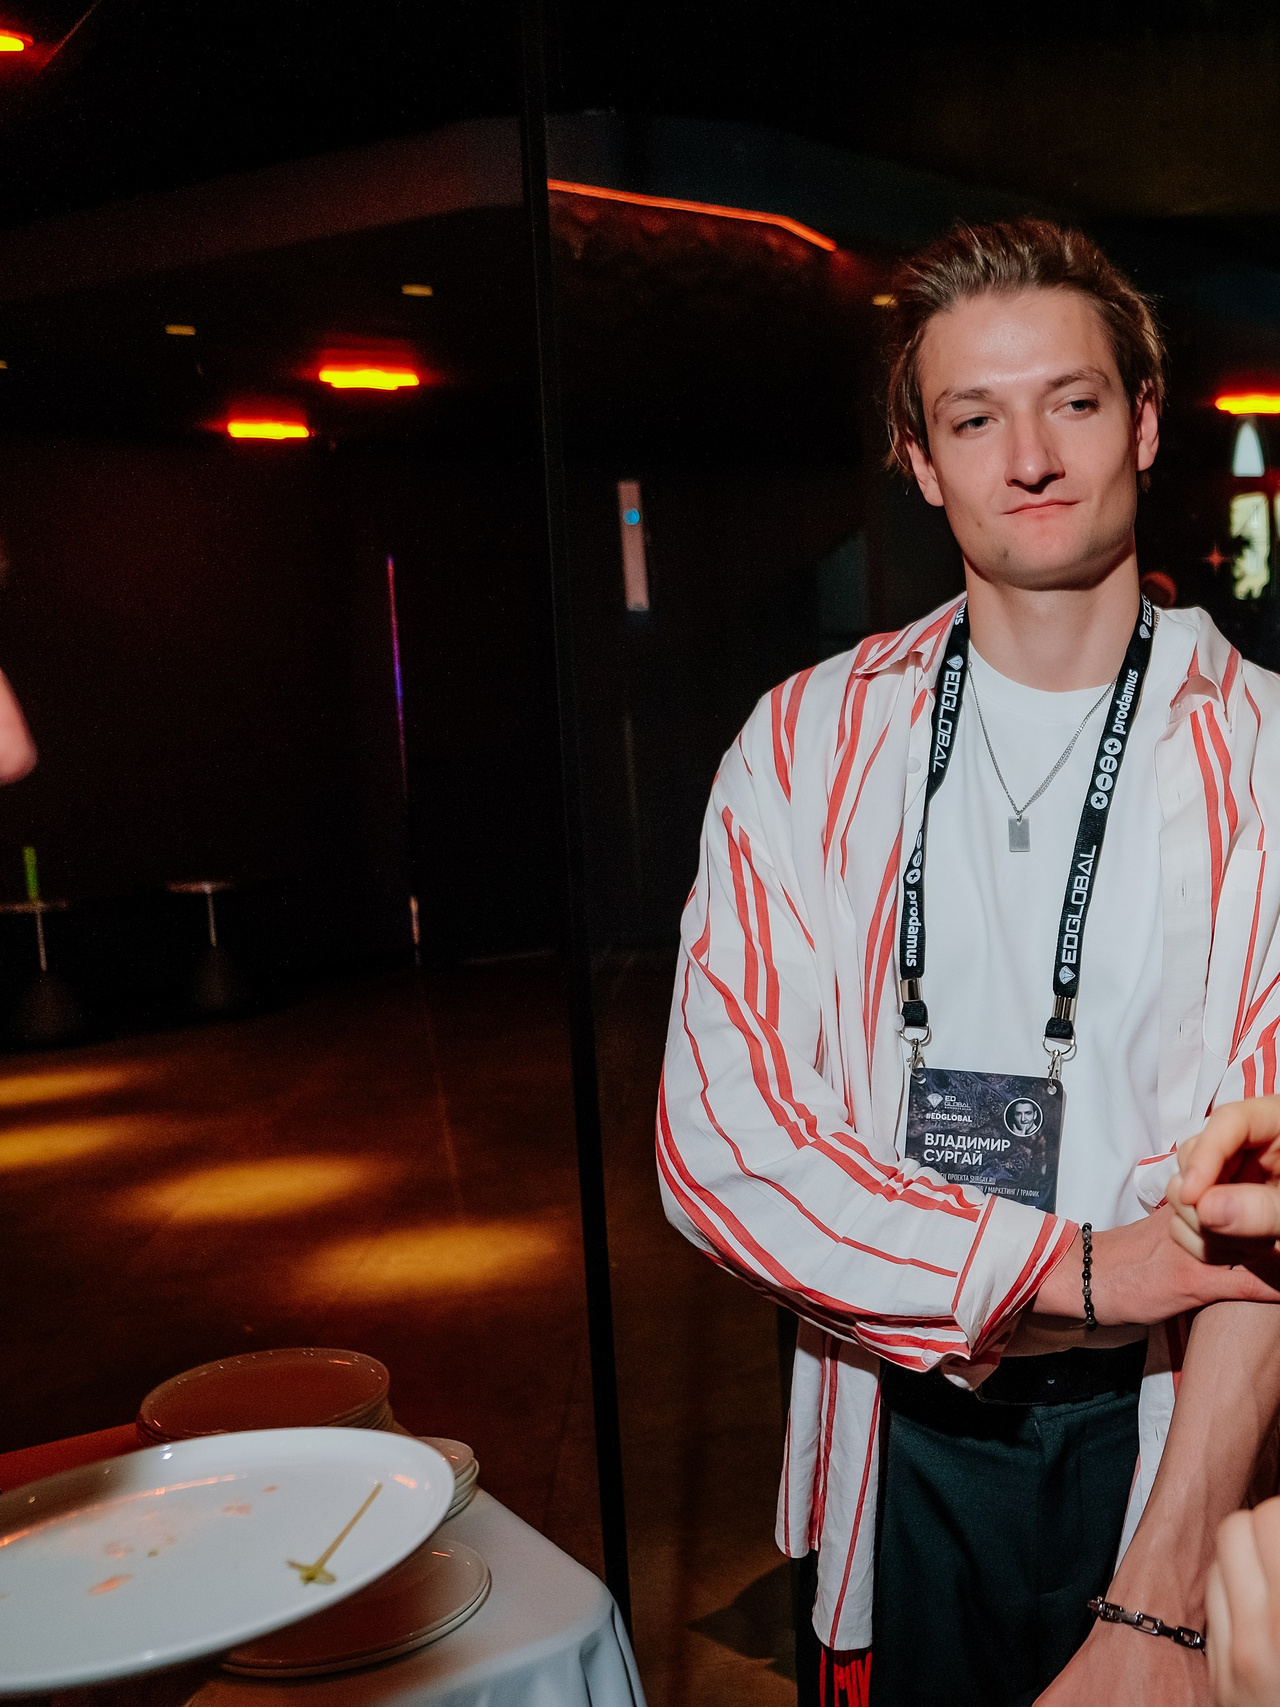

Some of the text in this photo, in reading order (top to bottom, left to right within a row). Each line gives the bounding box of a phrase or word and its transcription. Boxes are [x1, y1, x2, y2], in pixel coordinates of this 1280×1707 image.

[1112, 669, 1139, 735] prodamus
[932, 671, 961, 774] EDGLOBAL
[1060, 844, 1097, 965] EDGLOBAL
[906, 890, 920, 968] prodamus
[925, 1112, 973, 1123] #EDGLOBAL
[924, 1133, 1011, 1152] ВЛАДИМИР
[923, 1148, 983, 1166] СУРГАЙ
[947, 1173, 970, 1183] ПРОЕКТА
[987, 1186, 1016, 1196] МАРКЕТИНГ
[1020, 1188, 1040, 1198] ТРАФИК
